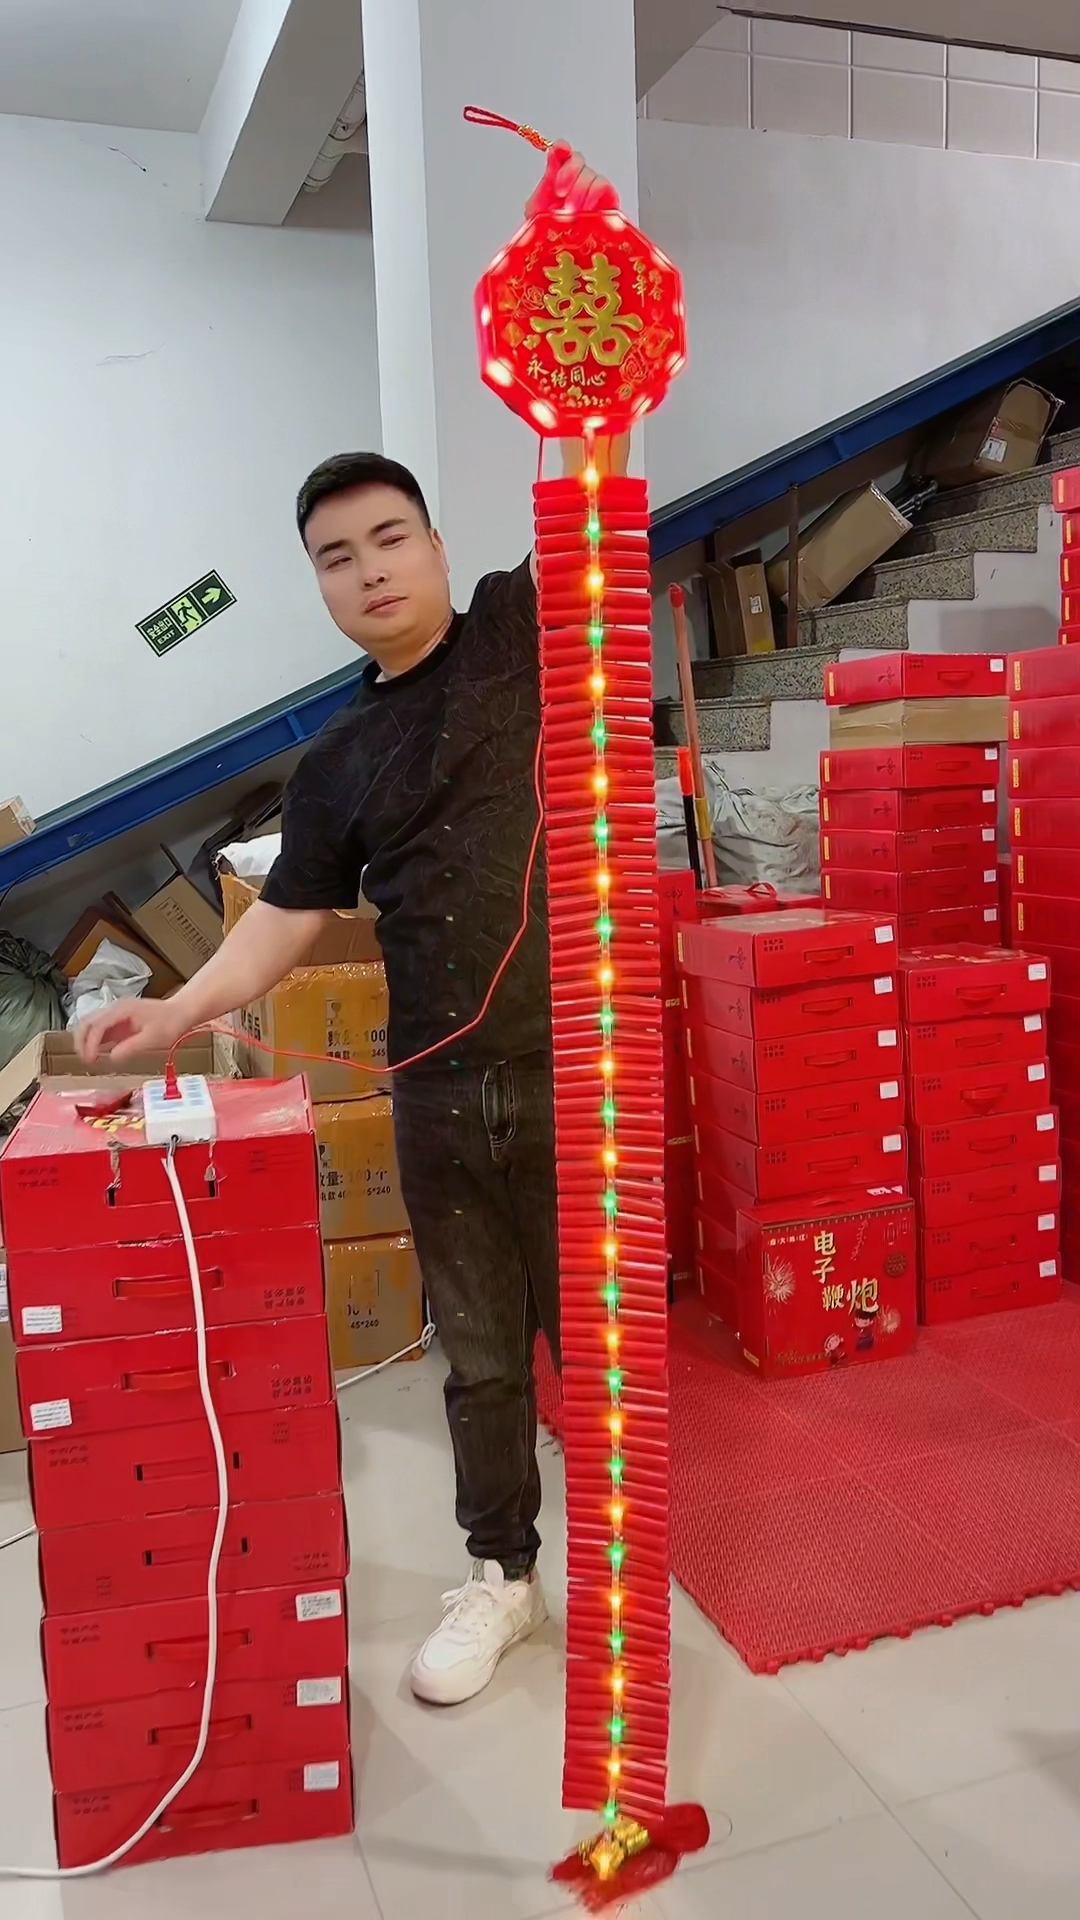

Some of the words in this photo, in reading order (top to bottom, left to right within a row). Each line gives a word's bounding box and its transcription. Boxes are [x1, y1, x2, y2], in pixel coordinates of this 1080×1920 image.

[527, 354, 607, 388] 永结同心
[146, 617, 173, 640] 安全出口
[157, 629, 176, 645] EXIT
